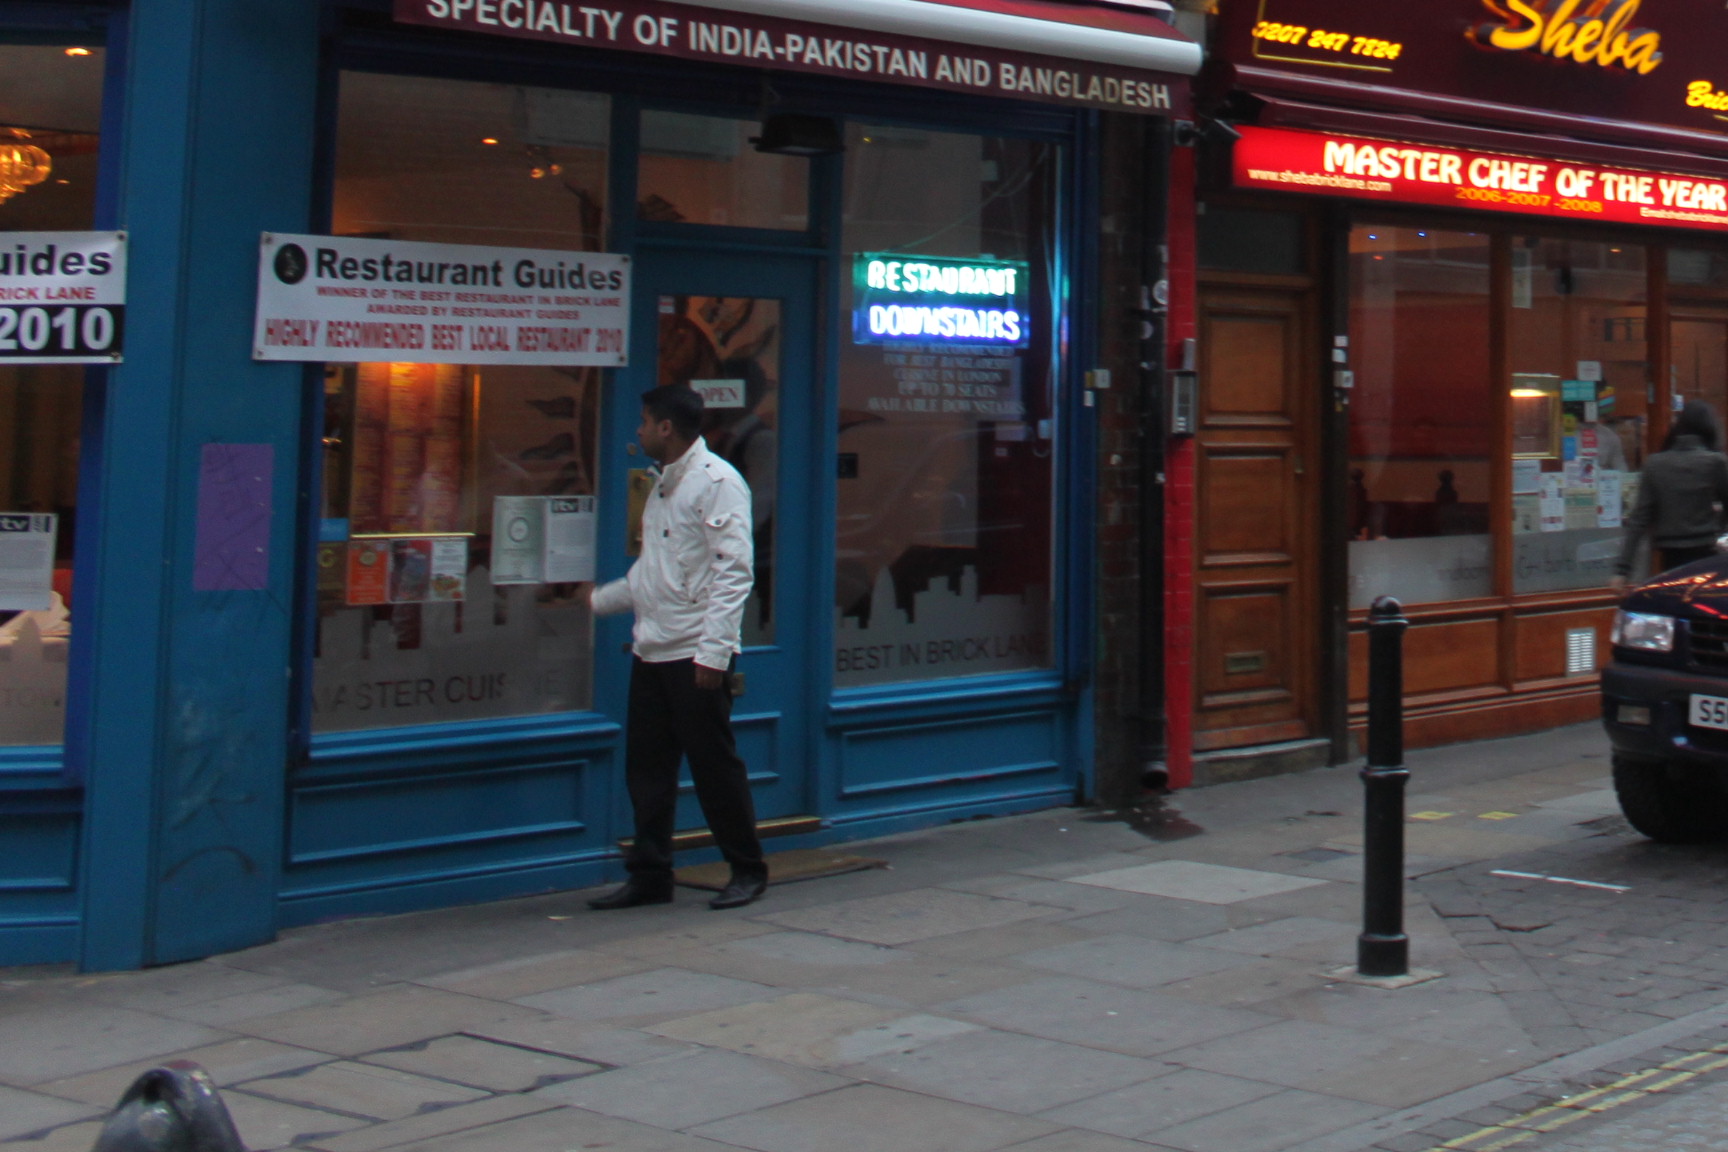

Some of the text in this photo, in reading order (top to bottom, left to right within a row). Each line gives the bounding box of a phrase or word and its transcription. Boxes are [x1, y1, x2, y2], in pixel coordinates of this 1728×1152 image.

[1307, 29, 1350, 52] 247
[633, 12, 678, 48] OF
[688, 19, 929, 80] INDIA-PAKISTAN
[935, 51, 991, 88] AND
[998, 62, 1171, 111] BANGLADESH
[1323, 141, 1728, 212] MASTER CHEF OF THE YEAR
[315, 247, 623, 291] Restaurant Guides
[867, 259, 1018, 296] RESTAURANT
[45, 287, 97, 300] LANE
[316, 285, 622, 308] WINNER OF THE BEST RESTAURANT IN BRICK LANE
[366, 302, 581, 321] AWARDED BY RESTAURANT GUIDES
[0, 307, 115, 351] 2010
[265, 318, 320, 348] HIGHLY
[325, 320, 425, 350] RECOMMENDED
[431, 324, 464, 351] BEST
[469, 324, 511, 352] LOCAL
[516, 326, 591, 353] RESTAURANT
[868, 304, 1022, 341] DOWNSTAIRS
[836, 644, 894, 672] BEST
[900, 643, 921, 667] IN
[926, 637, 990, 665] BRICK
